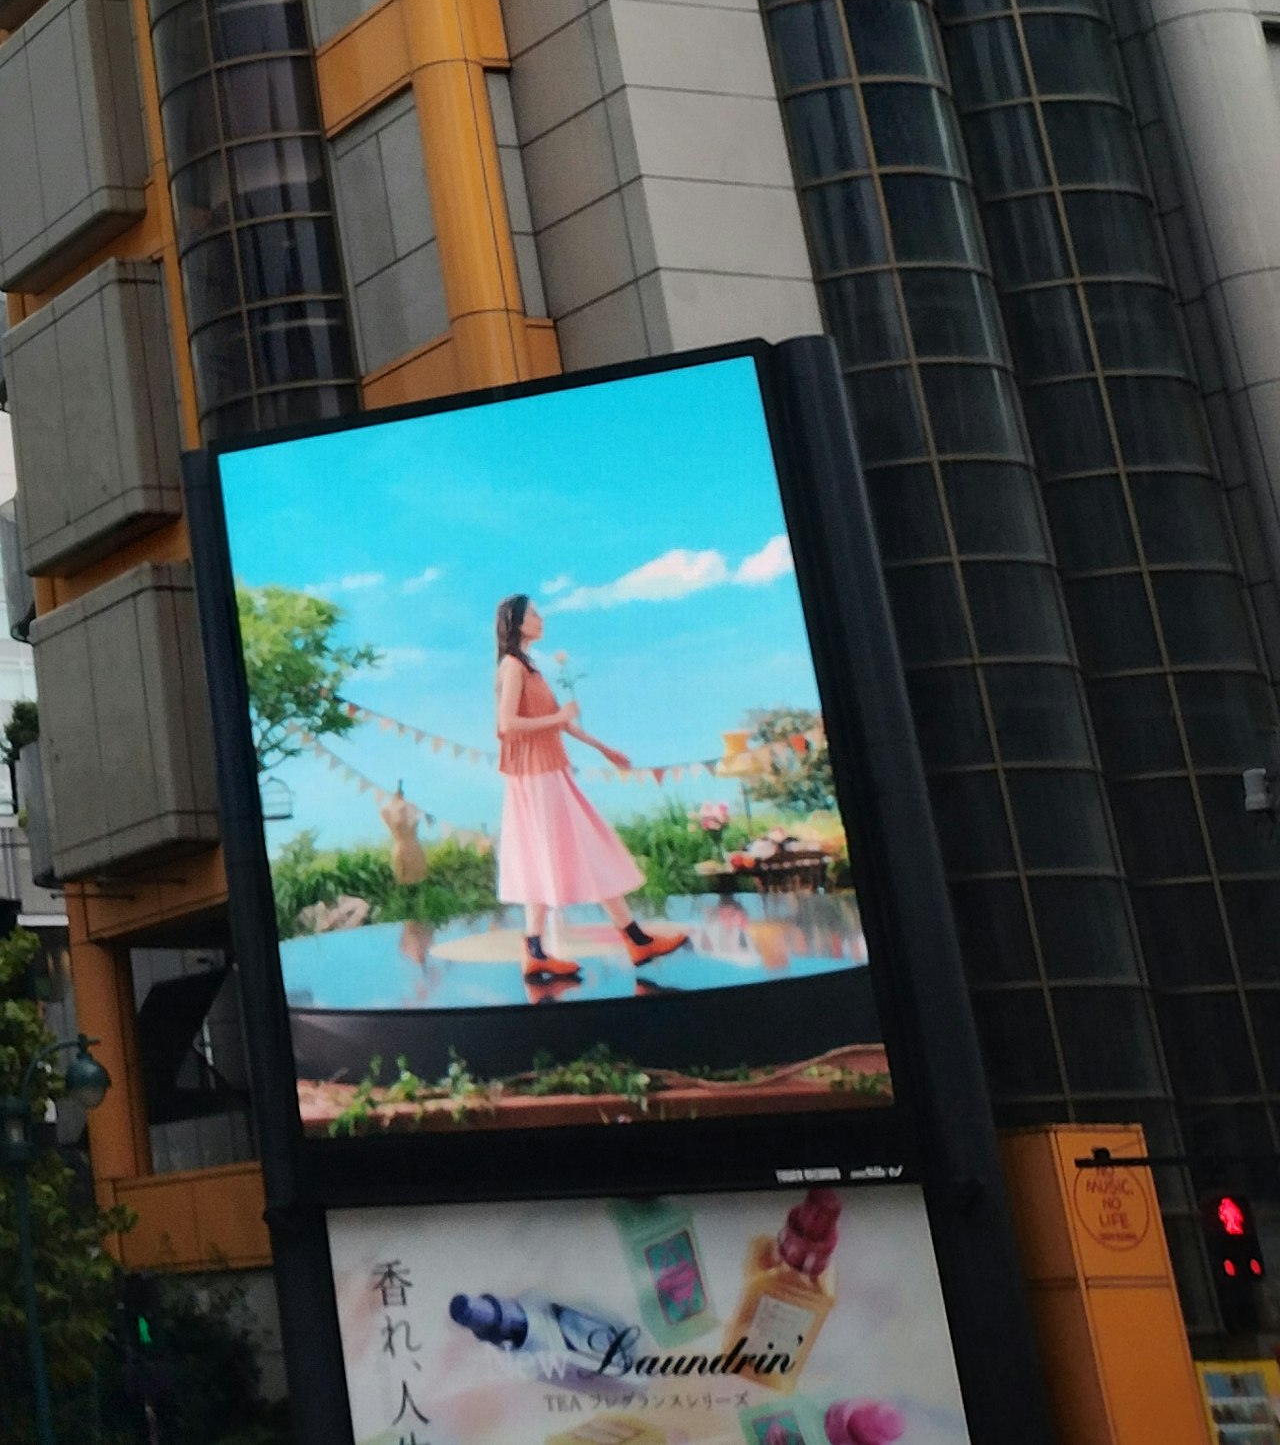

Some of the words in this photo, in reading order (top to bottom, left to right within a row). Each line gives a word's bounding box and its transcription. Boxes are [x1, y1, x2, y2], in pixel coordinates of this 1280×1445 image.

[373, 1260, 430, 1445] 香れ、人
[543, 1393, 583, 1413] TEA
